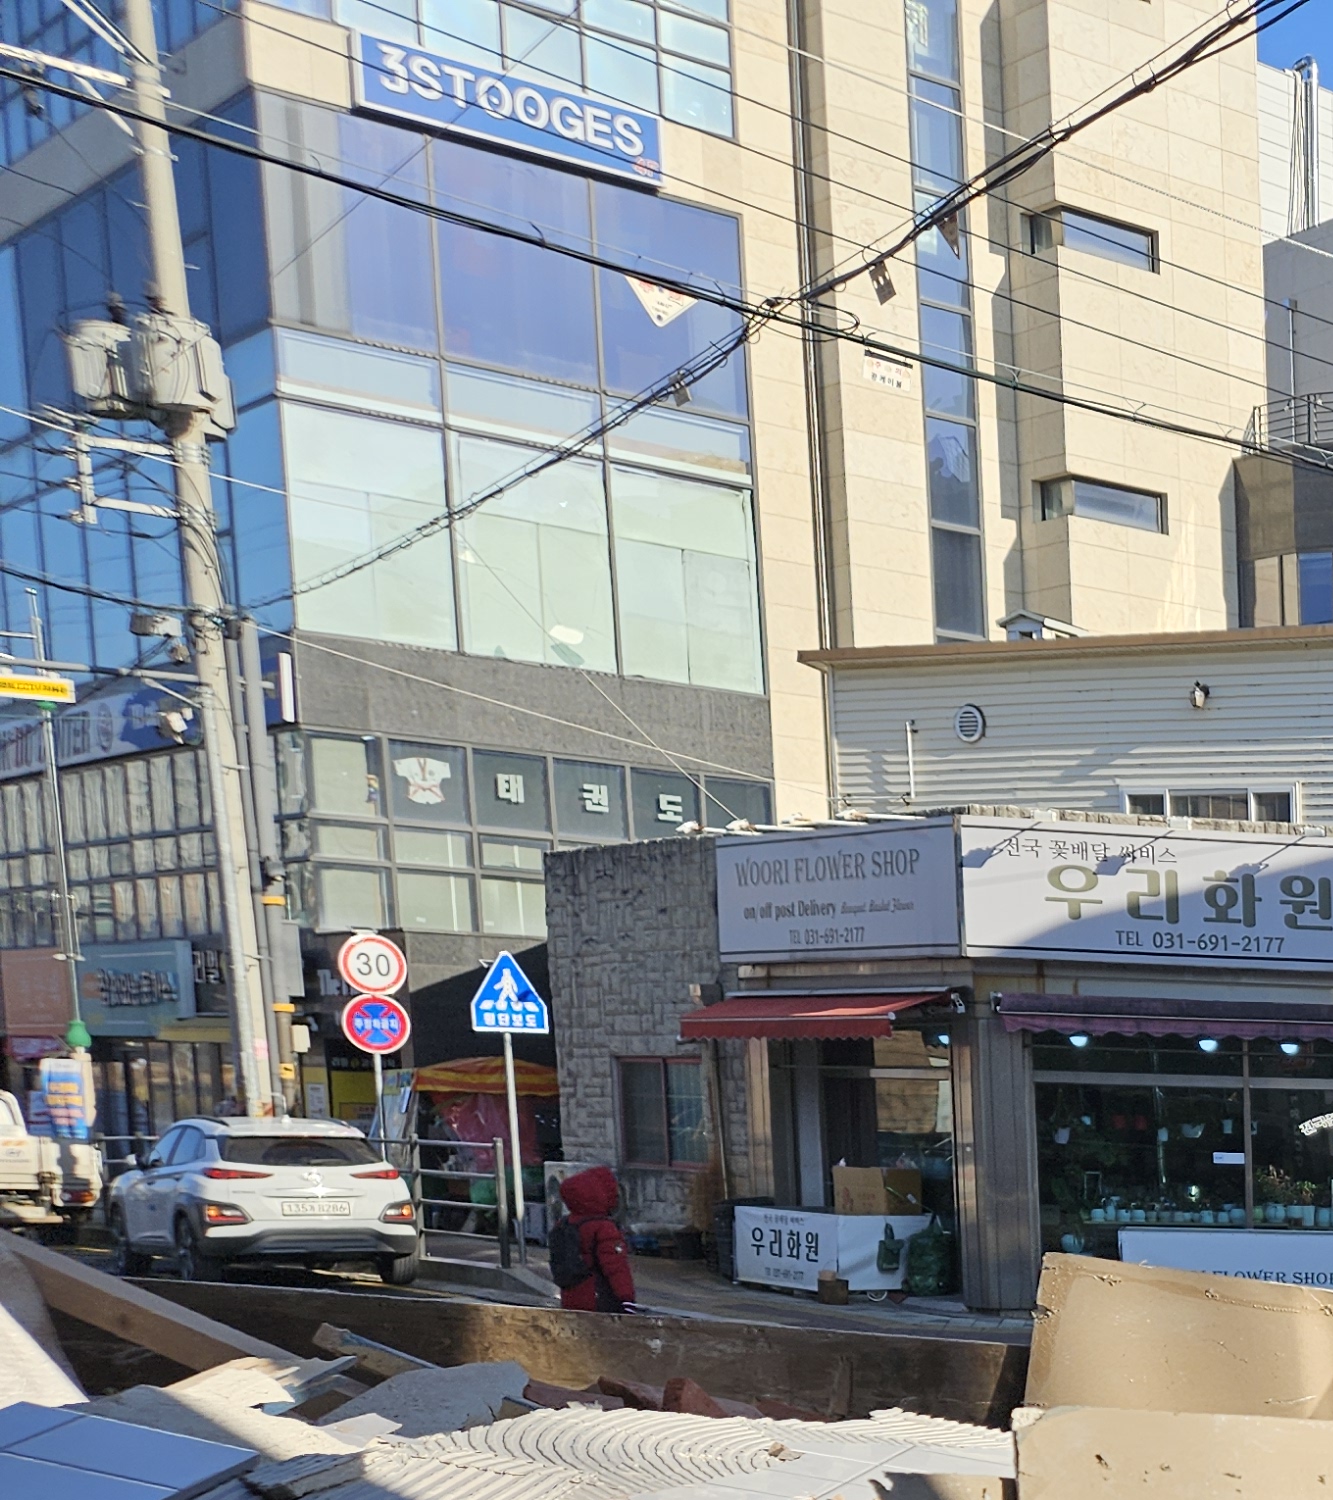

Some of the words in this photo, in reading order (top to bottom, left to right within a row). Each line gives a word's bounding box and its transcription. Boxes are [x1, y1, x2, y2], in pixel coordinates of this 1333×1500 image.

[1001, 838, 1042, 859] 전국
[1049, 839, 1109, 863] 꽃배달
[735, 857, 789, 888] WOORI
[794, 850, 867, 883] FLOWER
[871, 848, 920, 877] SHOP
[797, 900, 836, 920] Delivery
[1045, 864, 1333, 931] 우리화원
[789, 929, 801, 945] TEL
[804, 926, 866, 945] 031-691-2177
[1115, 930, 1144, 948] TEL
[1152, 931, 1286, 955] 031-691-2177
[356, 952, 391, 976] 30
[751, 1226, 819, 1263] 우리화원
